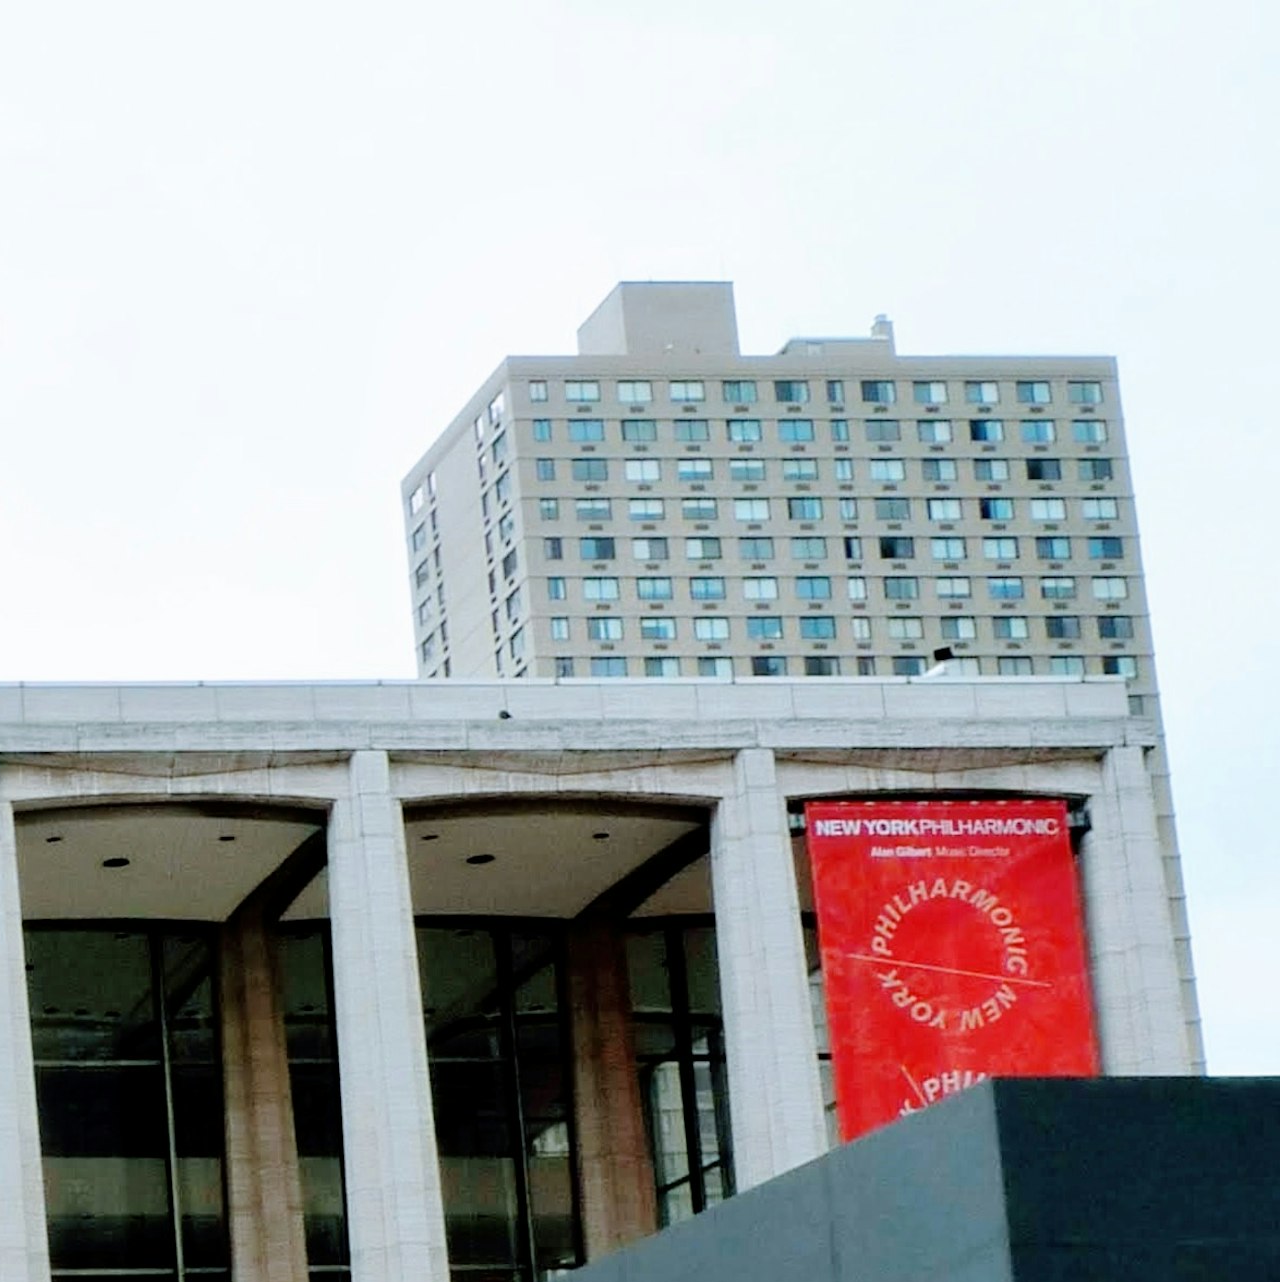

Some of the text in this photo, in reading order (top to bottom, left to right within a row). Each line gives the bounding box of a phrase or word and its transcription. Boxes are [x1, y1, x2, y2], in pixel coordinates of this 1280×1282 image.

[815, 818, 1060, 837] NEW YORK PHILHARMONIC
[871, 878, 1028, 976] PHILHARMONIC
[876, 969, 1017, 1032] NEW YORK
